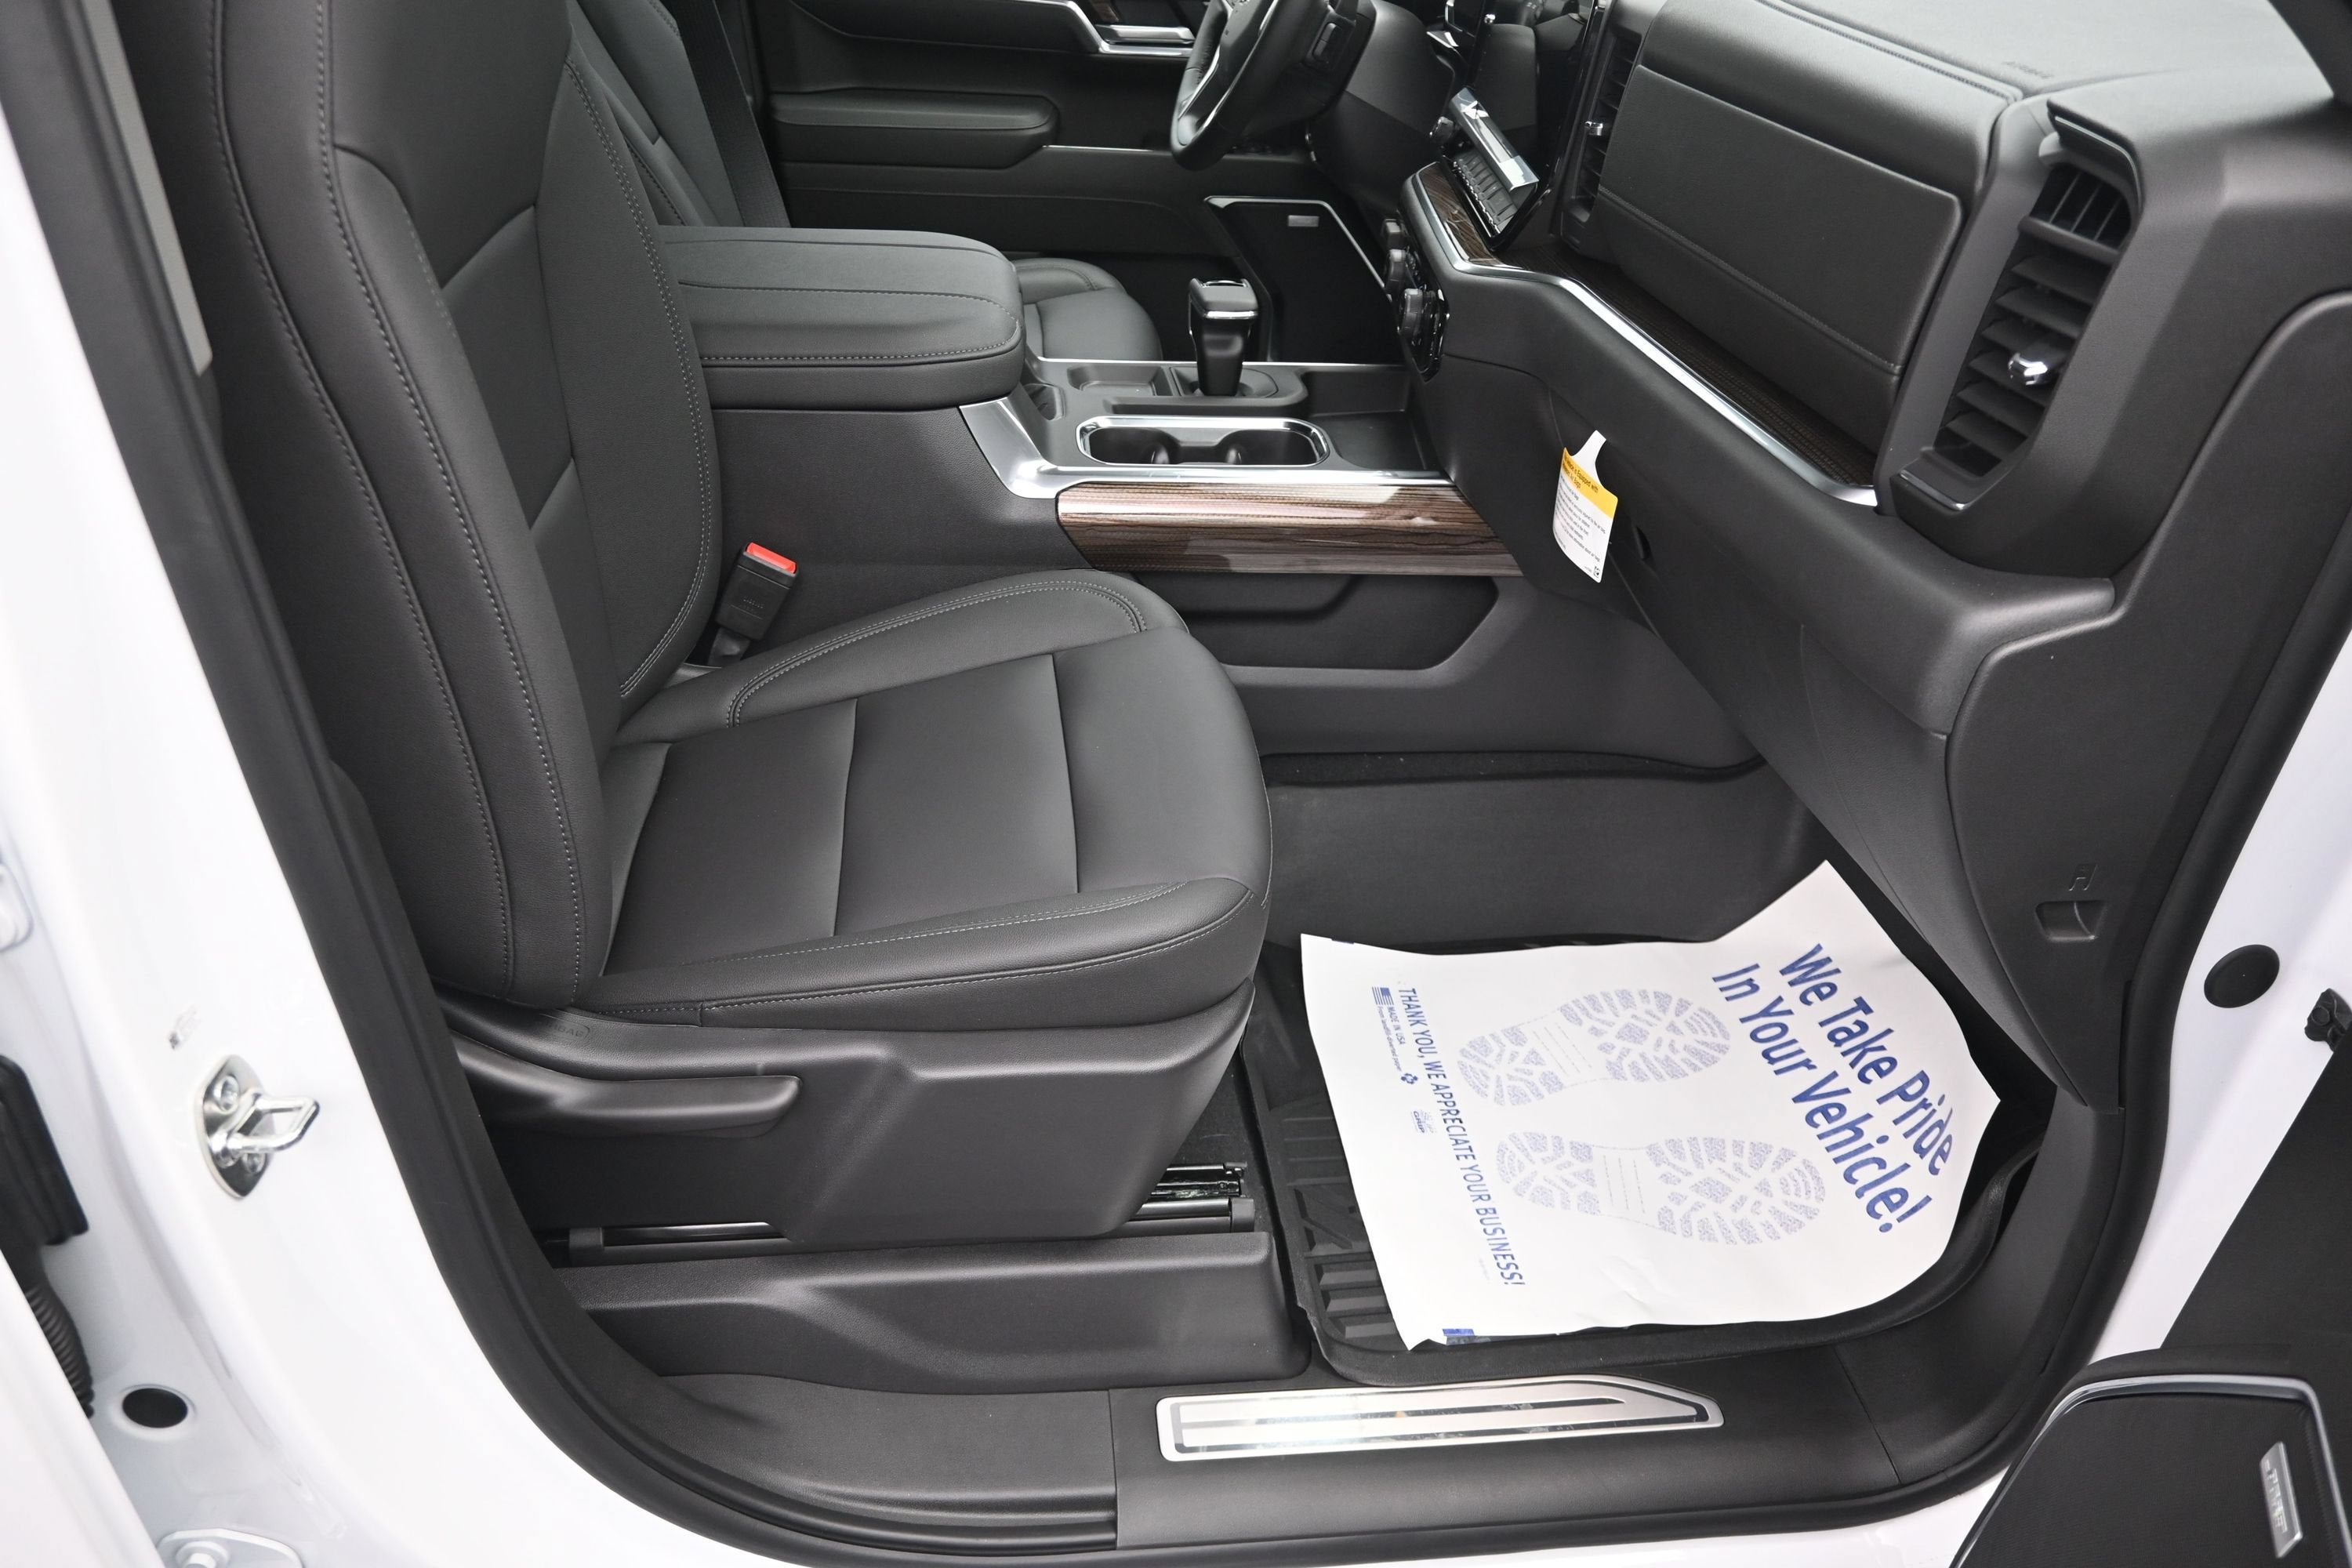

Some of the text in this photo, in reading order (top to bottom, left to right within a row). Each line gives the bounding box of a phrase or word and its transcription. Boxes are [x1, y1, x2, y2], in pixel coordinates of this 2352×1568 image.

[1387, 1006, 1399, 1022] MADE
[1396, 1032, 1406, 1045] USA
[1399, 988, 1428, 1027] THANK
[1413, 1029, 1438, 1059] YOU,
[1779, 943, 1953, 1176] We Take Pride
[1423, 1061, 1446, 1080] WE
[1712, 963, 1933, 1233] In Your Vehicle!
[1413, 1110, 1425, 1133] GRIP
[1431, 1083, 1476, 1161] APPRECIATE
[1460, 1164, 1492, 1203] YOUR
[1475, 1207, 1526, 1285] BUSINESS!
